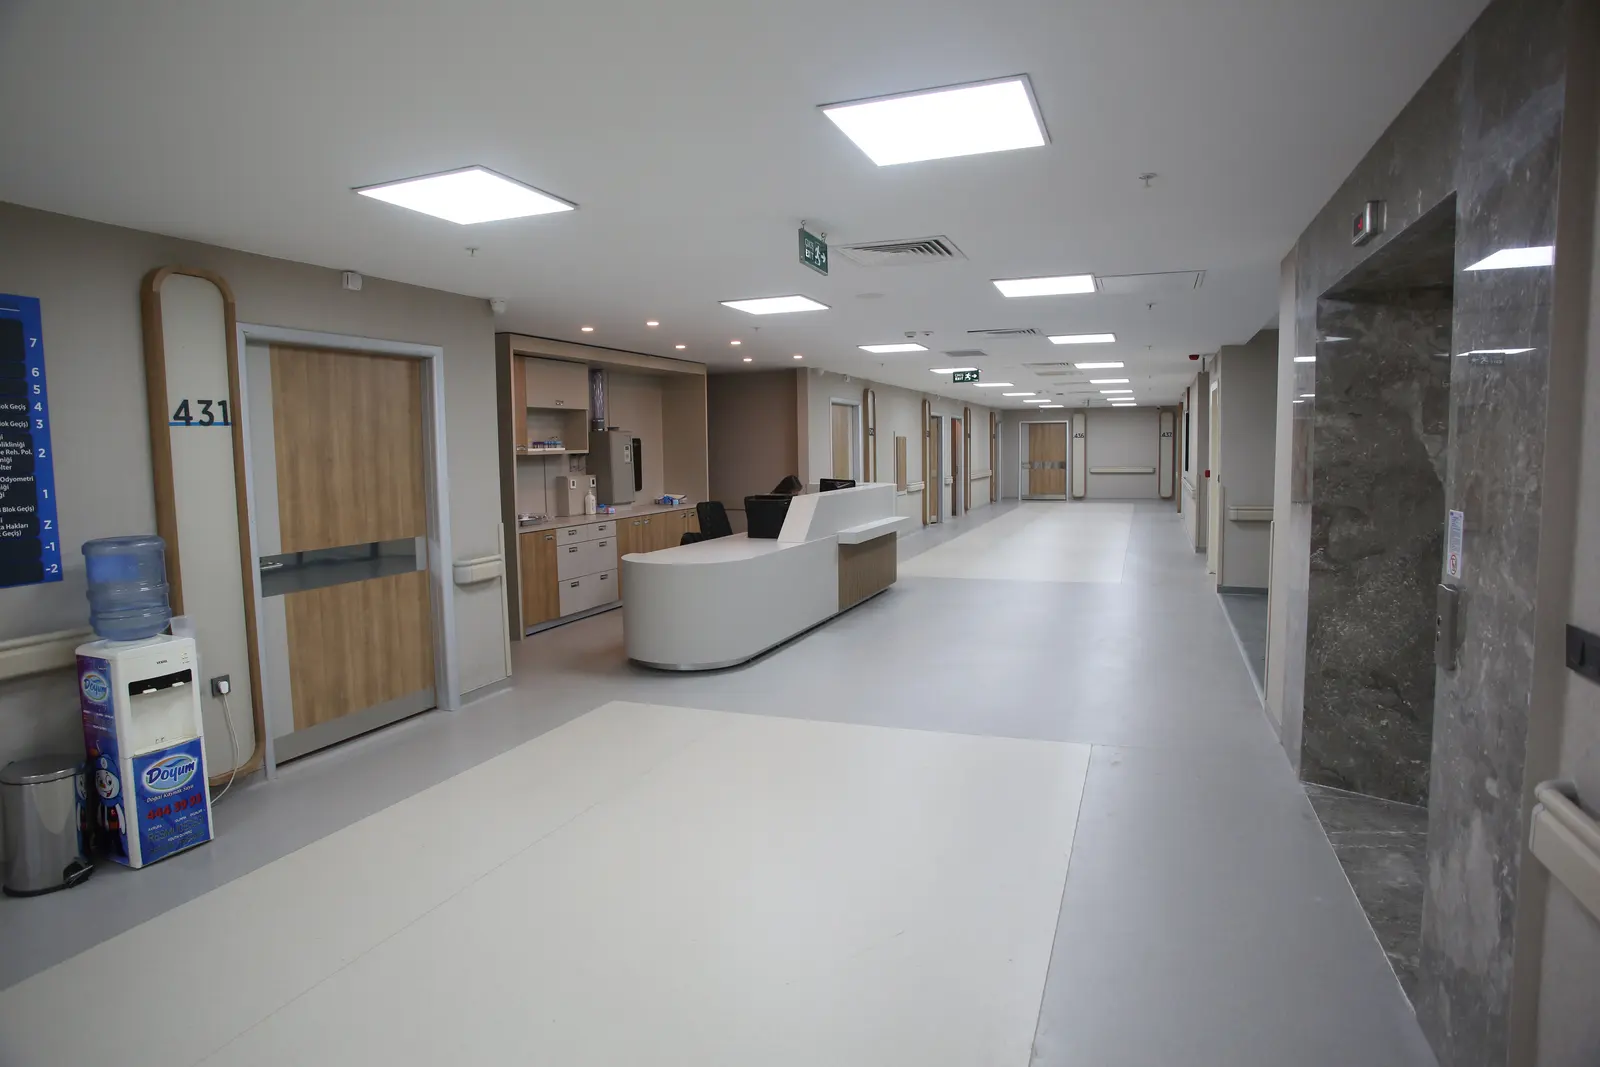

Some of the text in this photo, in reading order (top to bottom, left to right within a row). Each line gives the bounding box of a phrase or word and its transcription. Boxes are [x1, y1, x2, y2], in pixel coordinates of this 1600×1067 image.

[805, 248, 814, 260] EXIT
[29, 338, 37, 348] 7
[31, 367, 40, 377] 6
[33, 385, 41, 395] 5
[34, 402, 43, 411] 4
[173, 399, 228, 426] 431
[36, 419, 44, 429] 3
[38, 448, 46, 458] 2
[0, 476, 34, 484] Odyometri
[43, 489, 48, 498] 1
[16, 505, 35, 513] Geçiş)
[44, 520, 52, 530] Z
[2, 529, 22, 537] Geçiş)
[45, 541, 55, 551] -1
[45, 564, 58, 574] -2
[146, 761, 195, 784] Doyum
[146, 804, 171, 820] 444
[173, 799, 188, 813] 39
